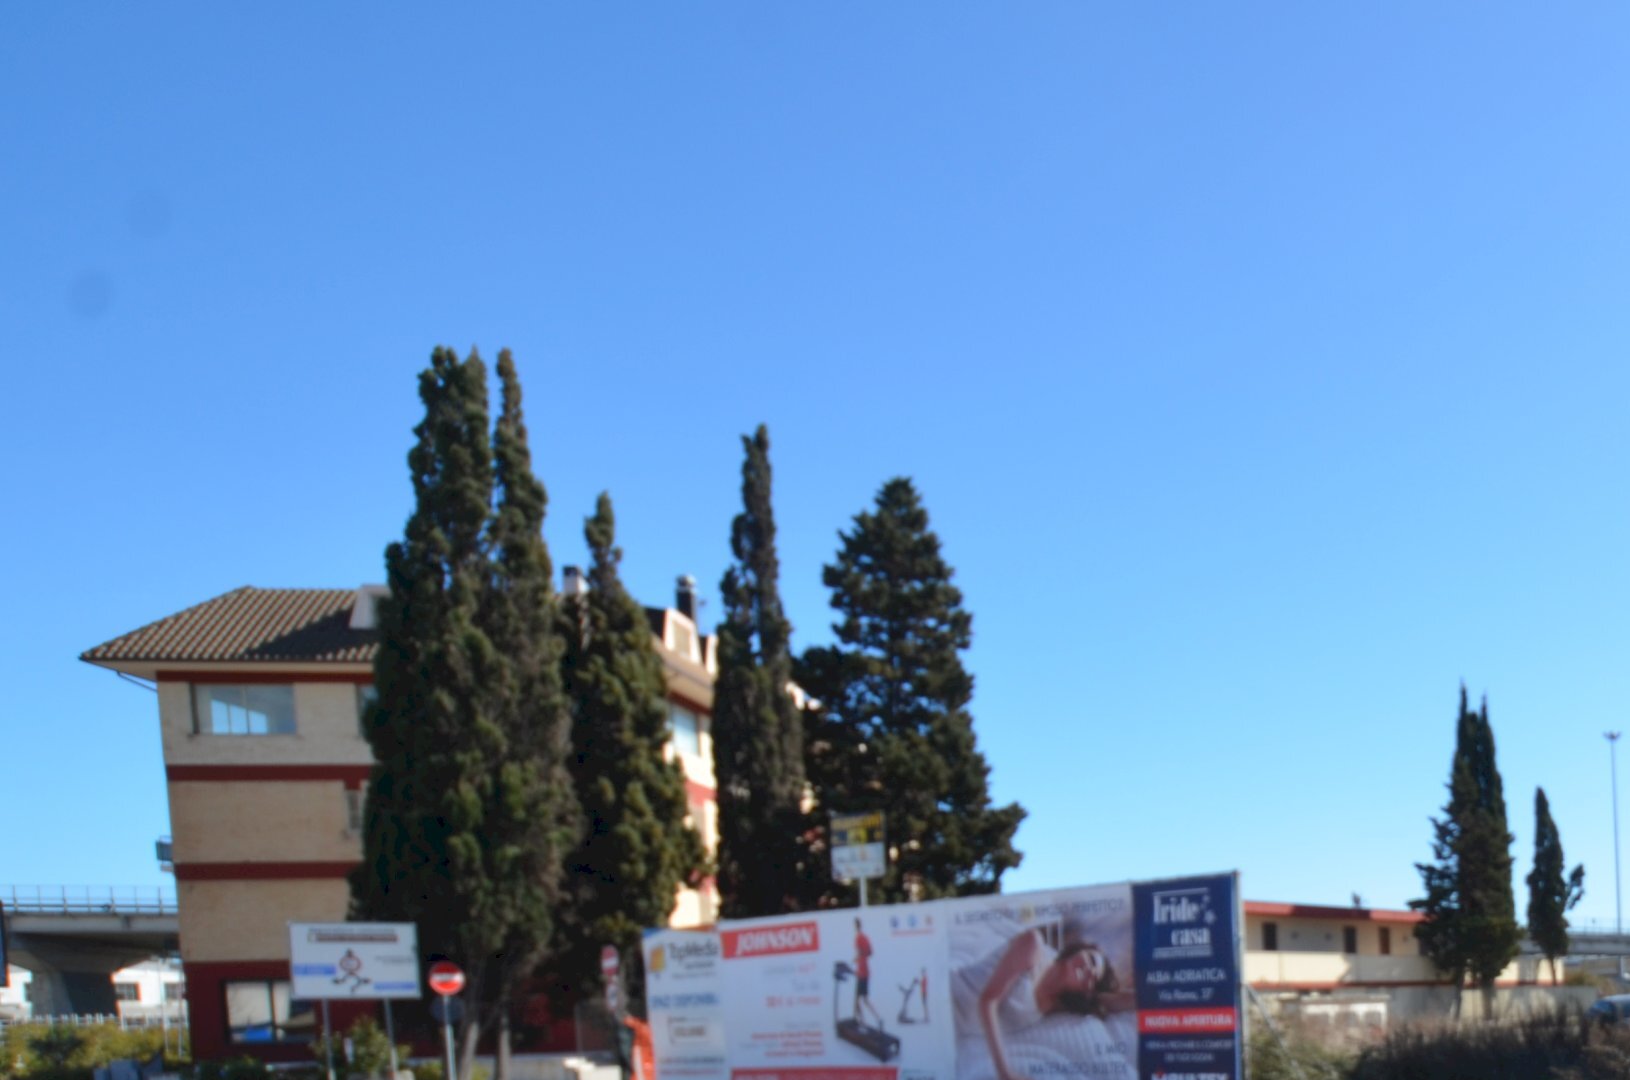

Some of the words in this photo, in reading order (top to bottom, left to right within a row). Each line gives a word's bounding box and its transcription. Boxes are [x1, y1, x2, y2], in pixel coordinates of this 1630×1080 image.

[1153, 895, 1199, 923] Iride
[736, 926, 812, 955] JOHNSON
[1171, 928, 1210, 946] casa
[1146, 971, 1170, 983] ALBA
[1174, 968, 1226, 982] ADRIATICA
[1145, 1015, 1179, 1027] NUOVA
[1182, 1013, 1233, 1026] APERTURA
